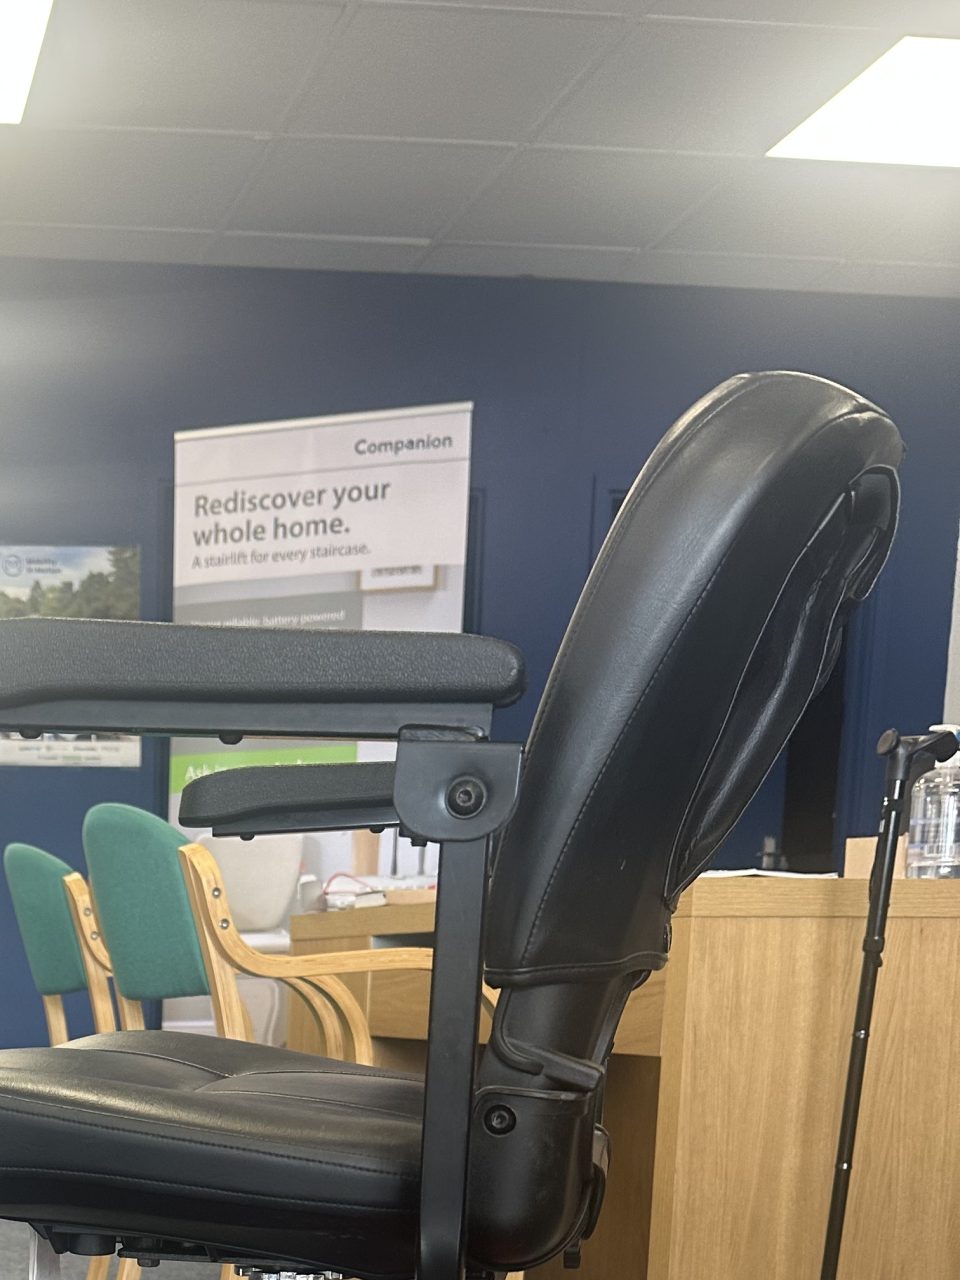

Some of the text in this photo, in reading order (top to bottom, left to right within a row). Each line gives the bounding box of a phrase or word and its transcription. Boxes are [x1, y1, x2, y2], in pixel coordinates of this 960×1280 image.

[354, 433, 453, 455] Companion
[194, 482, 390, 517] Rediscover your
[193, 516, 350, 546] whole home.
[192, 543, 371, 569] A stairlift for every staircase.
